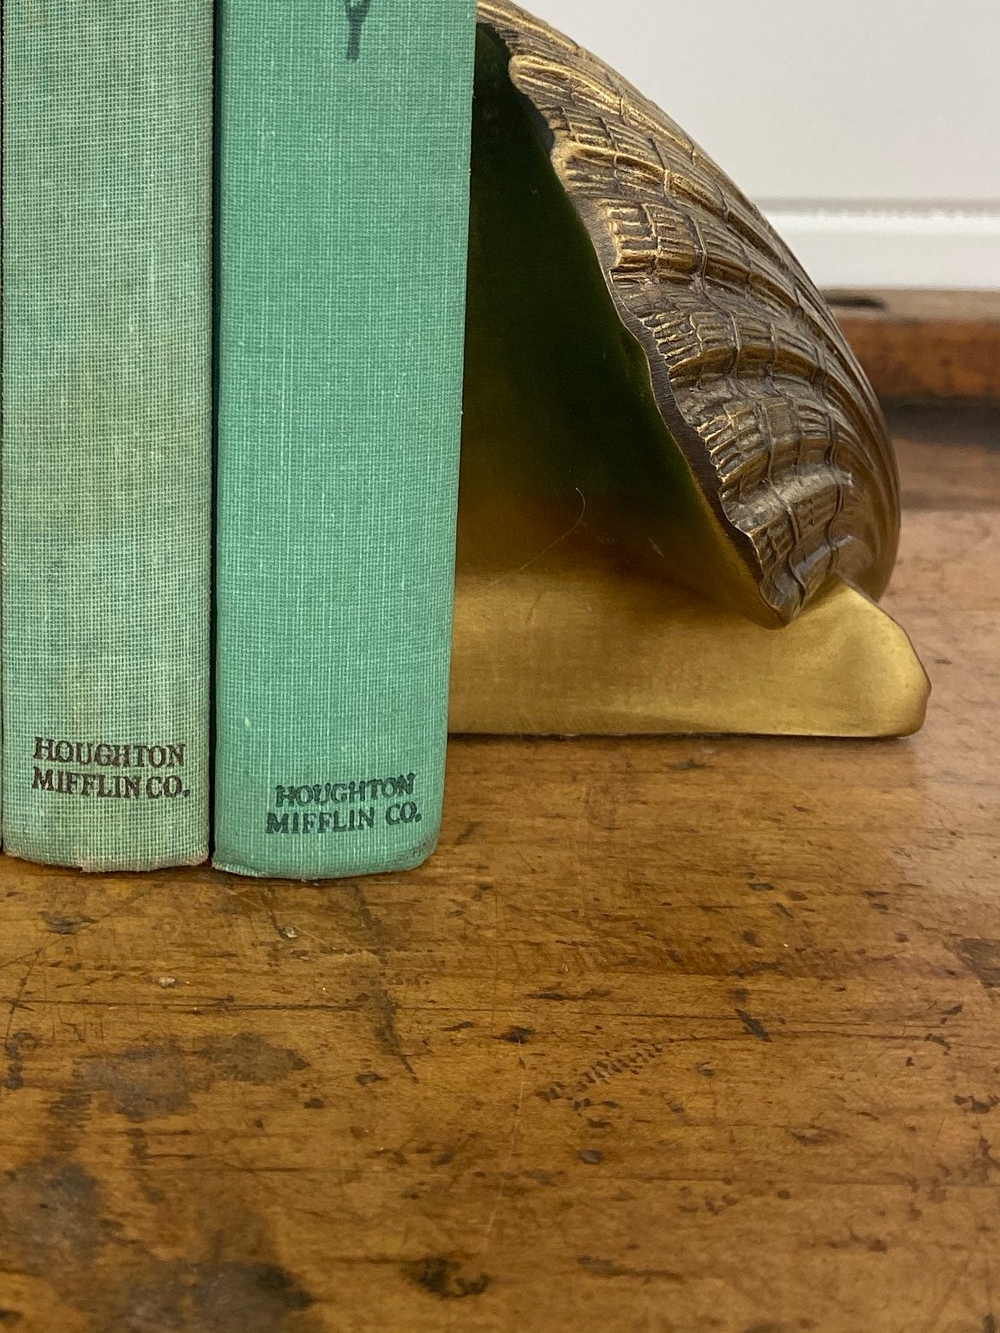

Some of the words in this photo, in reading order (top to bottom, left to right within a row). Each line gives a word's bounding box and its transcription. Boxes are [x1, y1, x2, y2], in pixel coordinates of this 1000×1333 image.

[33, 736, 186, 767] HOUGHTON
[32, 766, 141, 798] MIFFLIN
[146, 775, 191, 799] CO.
[276, 773, 416, 807] HOUGHTON
[266, 808, 374, 834] MIFFLIN
[386, 801, 422, 824] CO.
